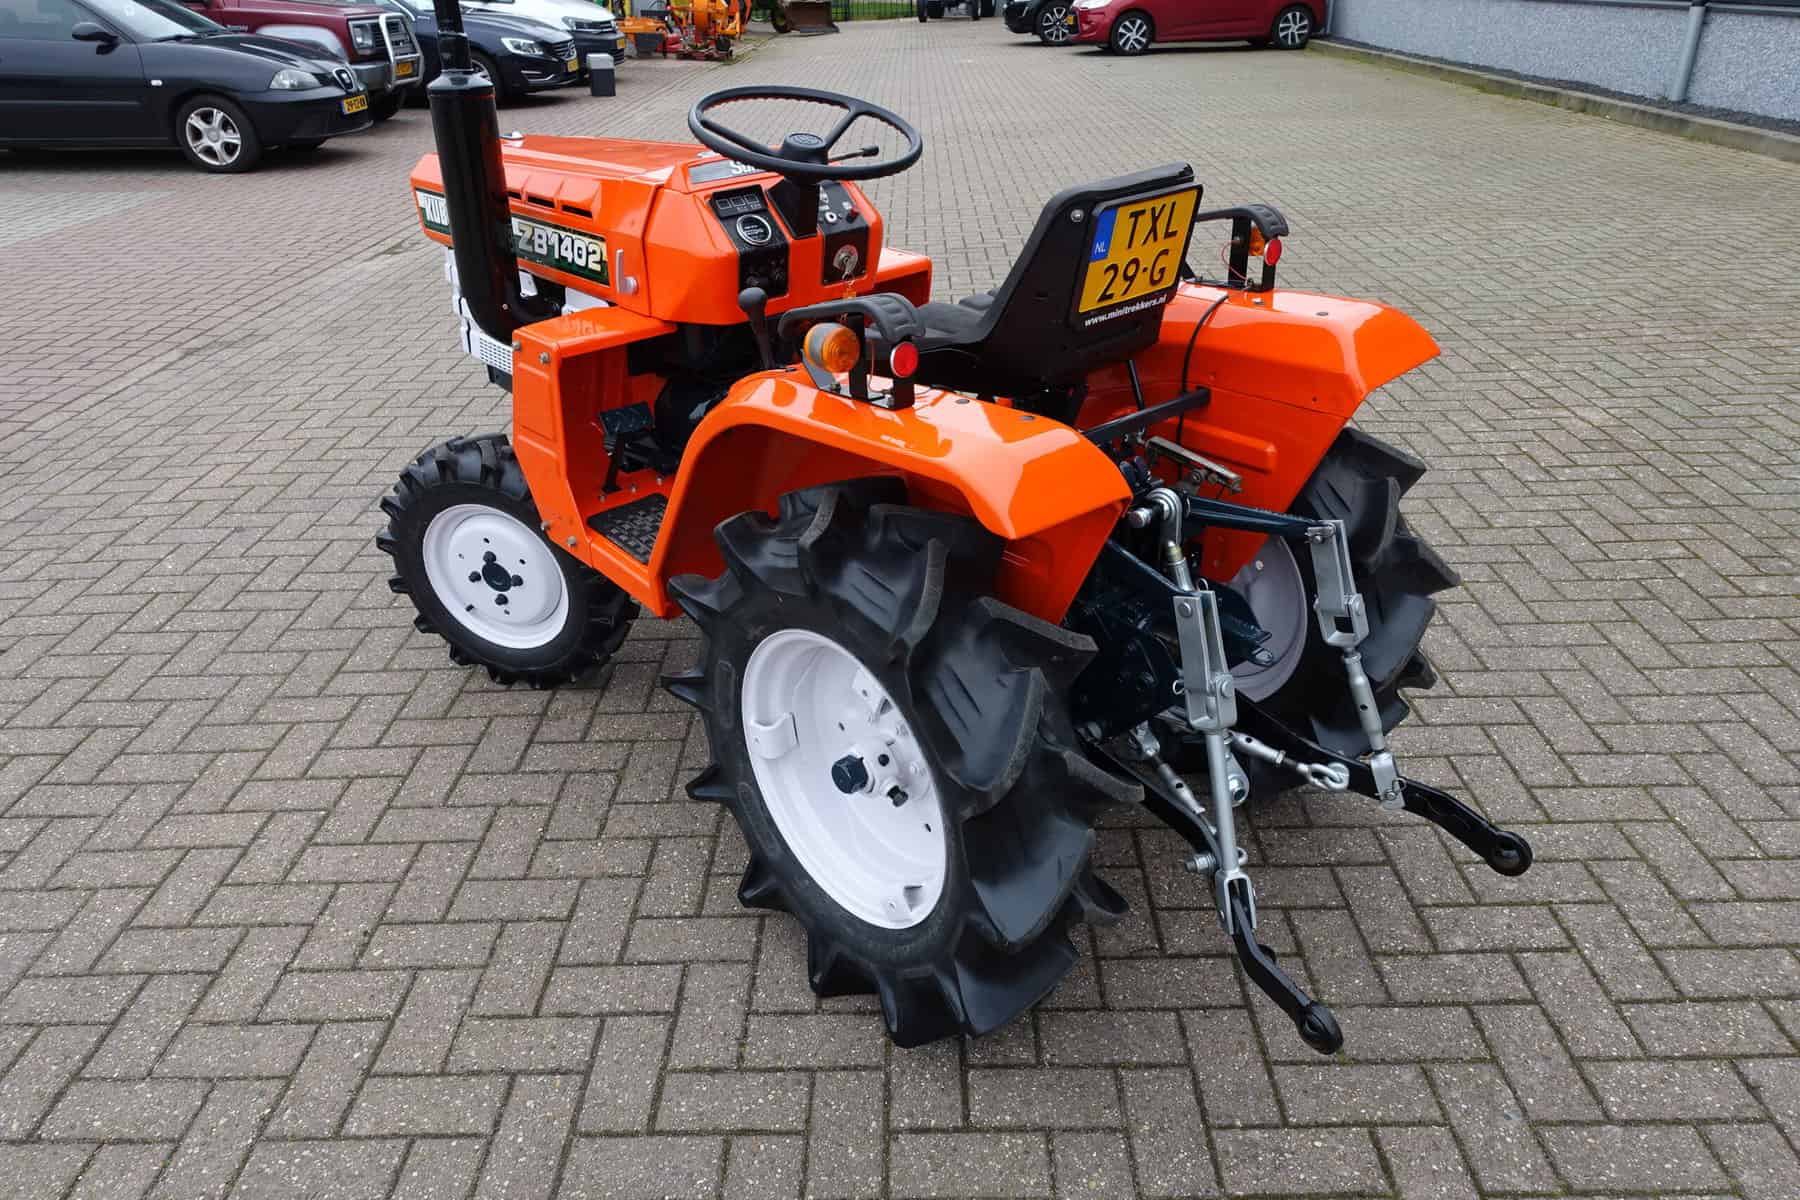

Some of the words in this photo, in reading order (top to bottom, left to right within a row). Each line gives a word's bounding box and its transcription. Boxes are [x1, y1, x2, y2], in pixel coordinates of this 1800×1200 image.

[1127, 201, 1179, 250] TXL
[518, 221, 602, 273] ZB1402
[1094, 241, 1106, 255] NL
[1084, 293, 1168, 327] www.minitrekkers.nl
